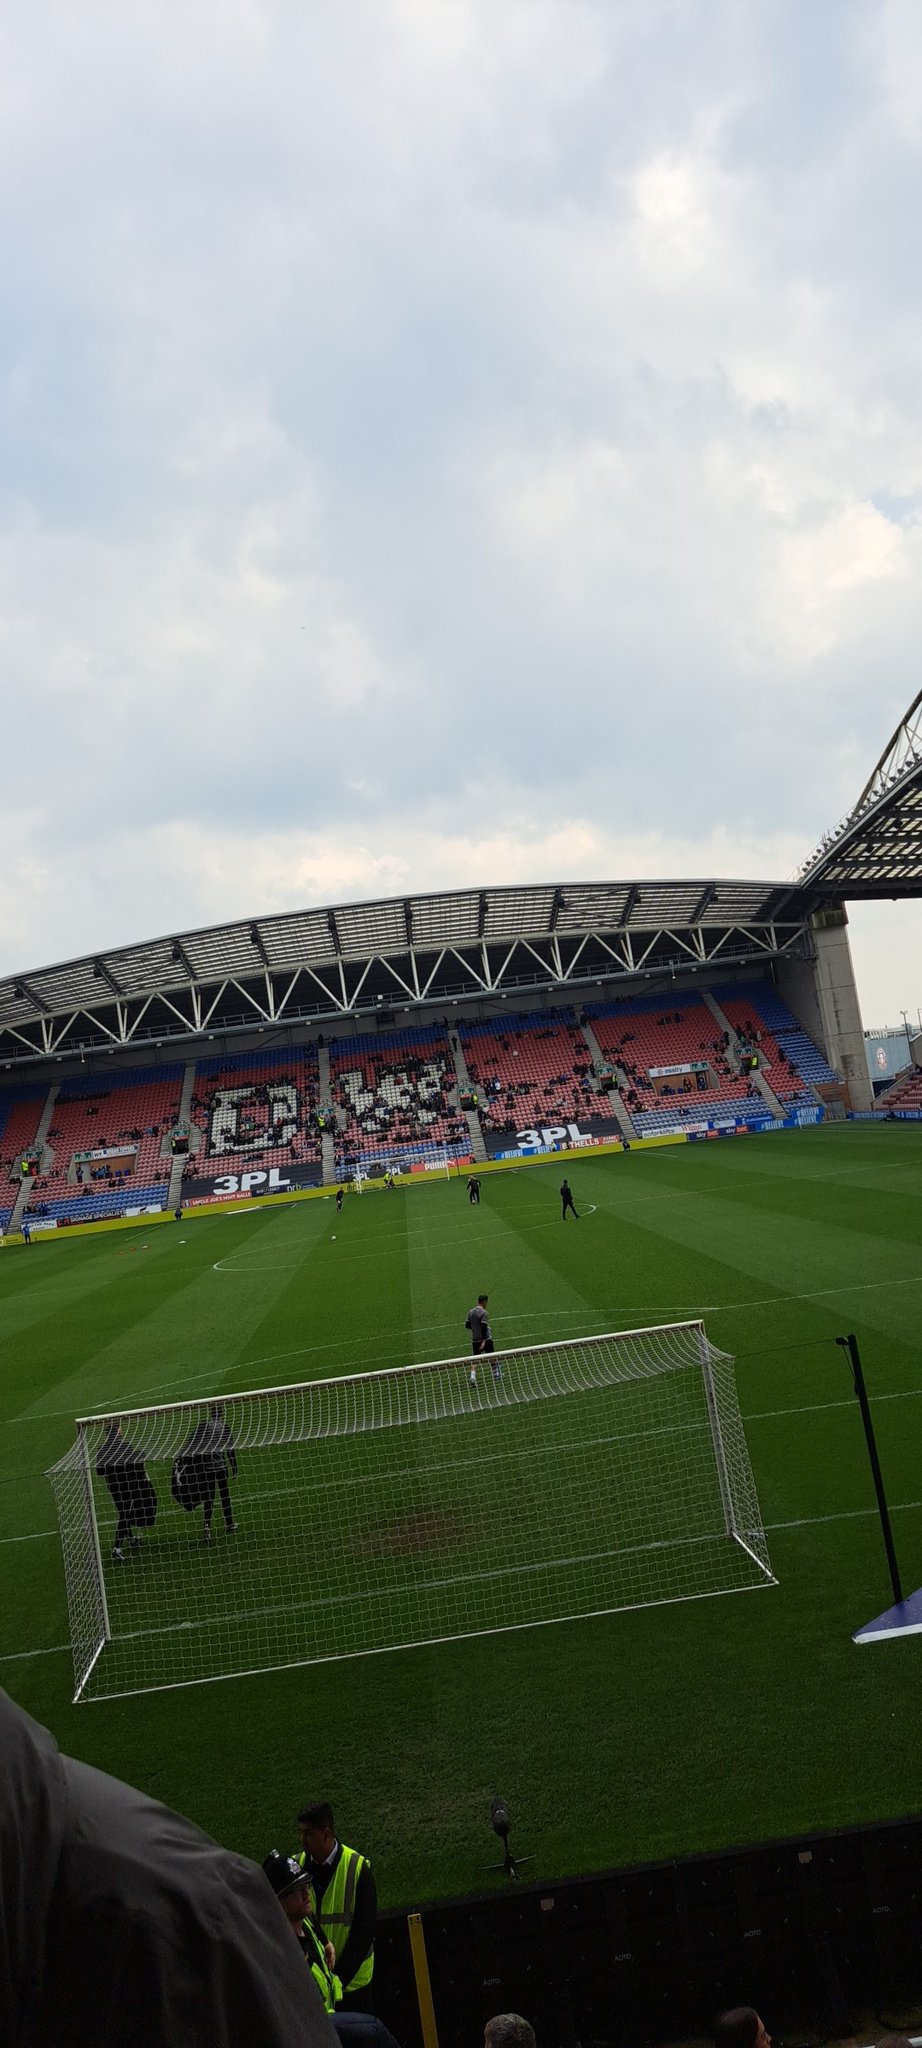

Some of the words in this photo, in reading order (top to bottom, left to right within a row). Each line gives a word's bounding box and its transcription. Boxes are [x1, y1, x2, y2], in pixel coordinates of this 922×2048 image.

[516, 1124, 593, 1149] 3PL
[562, 1137, 599, 1150] BTHELLS
[213, 1168, 290, 1195] 3PL
